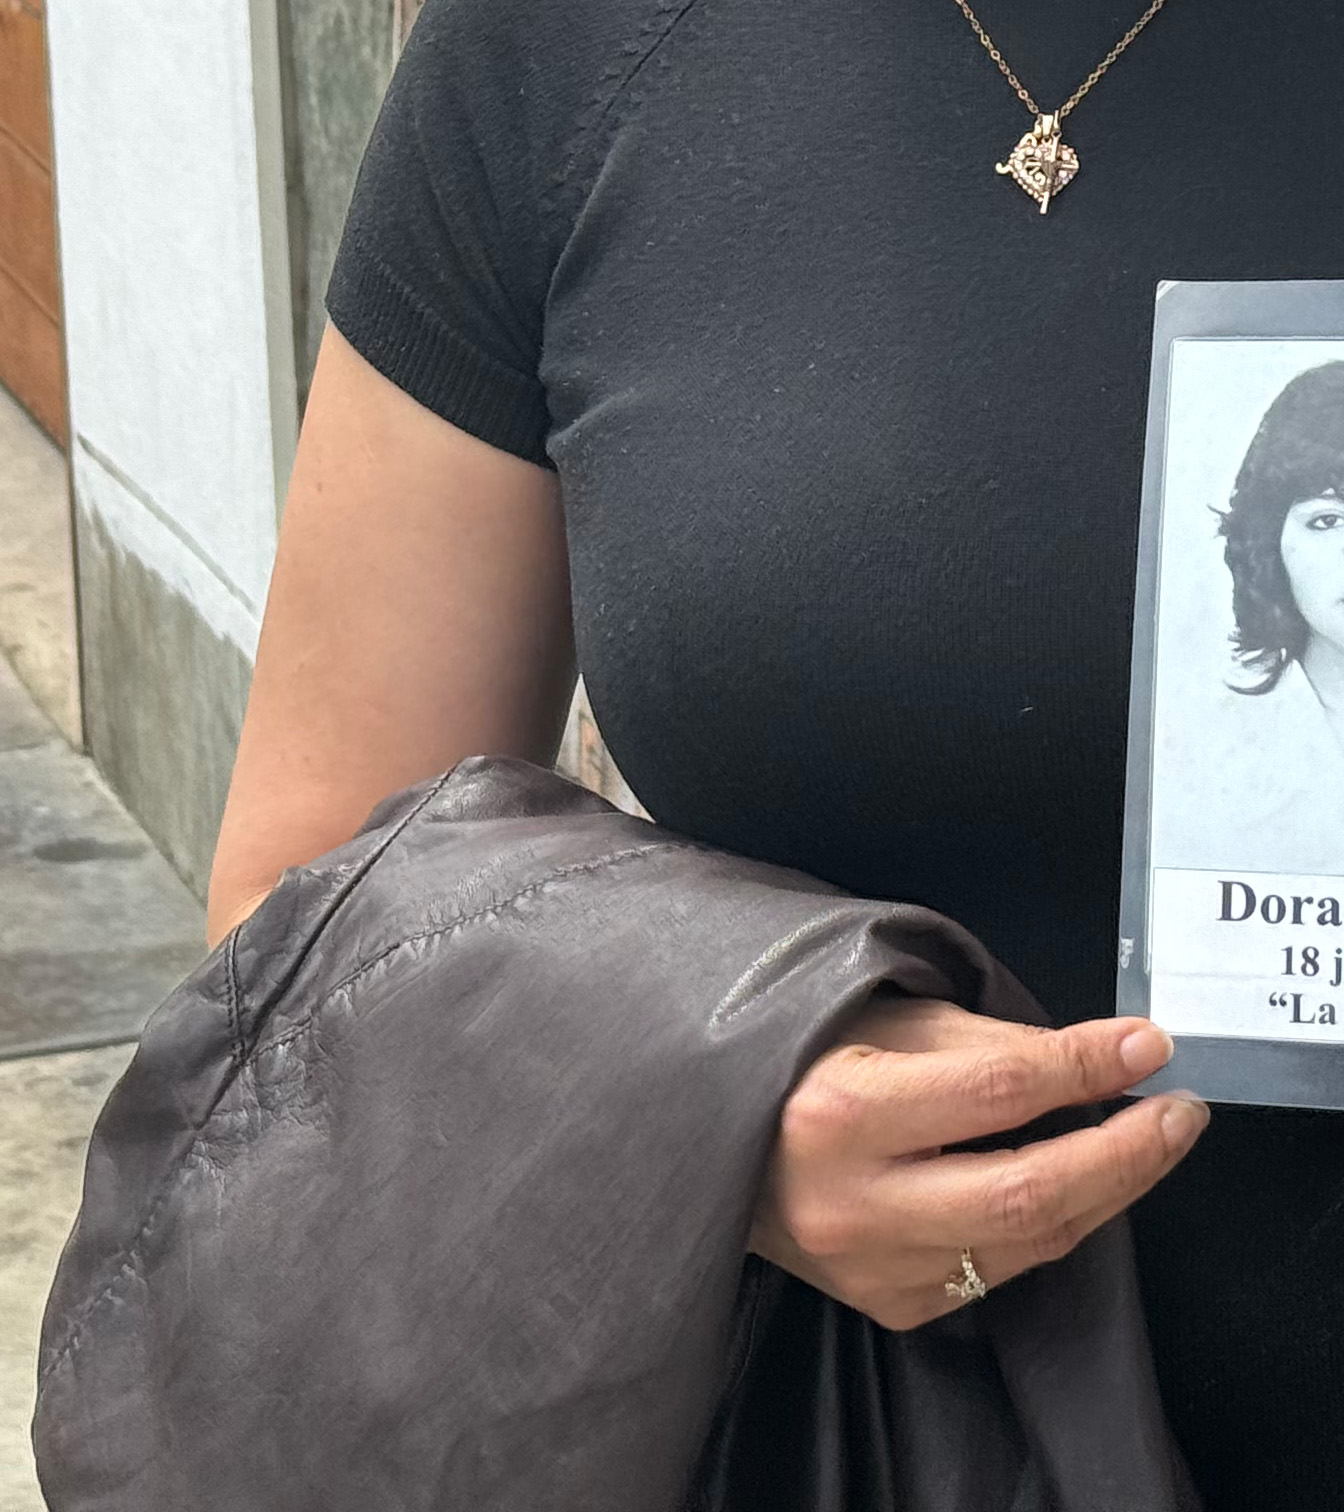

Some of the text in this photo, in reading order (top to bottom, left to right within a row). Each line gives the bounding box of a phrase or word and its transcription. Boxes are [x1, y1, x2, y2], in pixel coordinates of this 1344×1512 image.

[1215, 879, 1343, 927] Dora
[1280, 945, 1320, 978] 18
[1267, 990, 1338, 1026] “La
